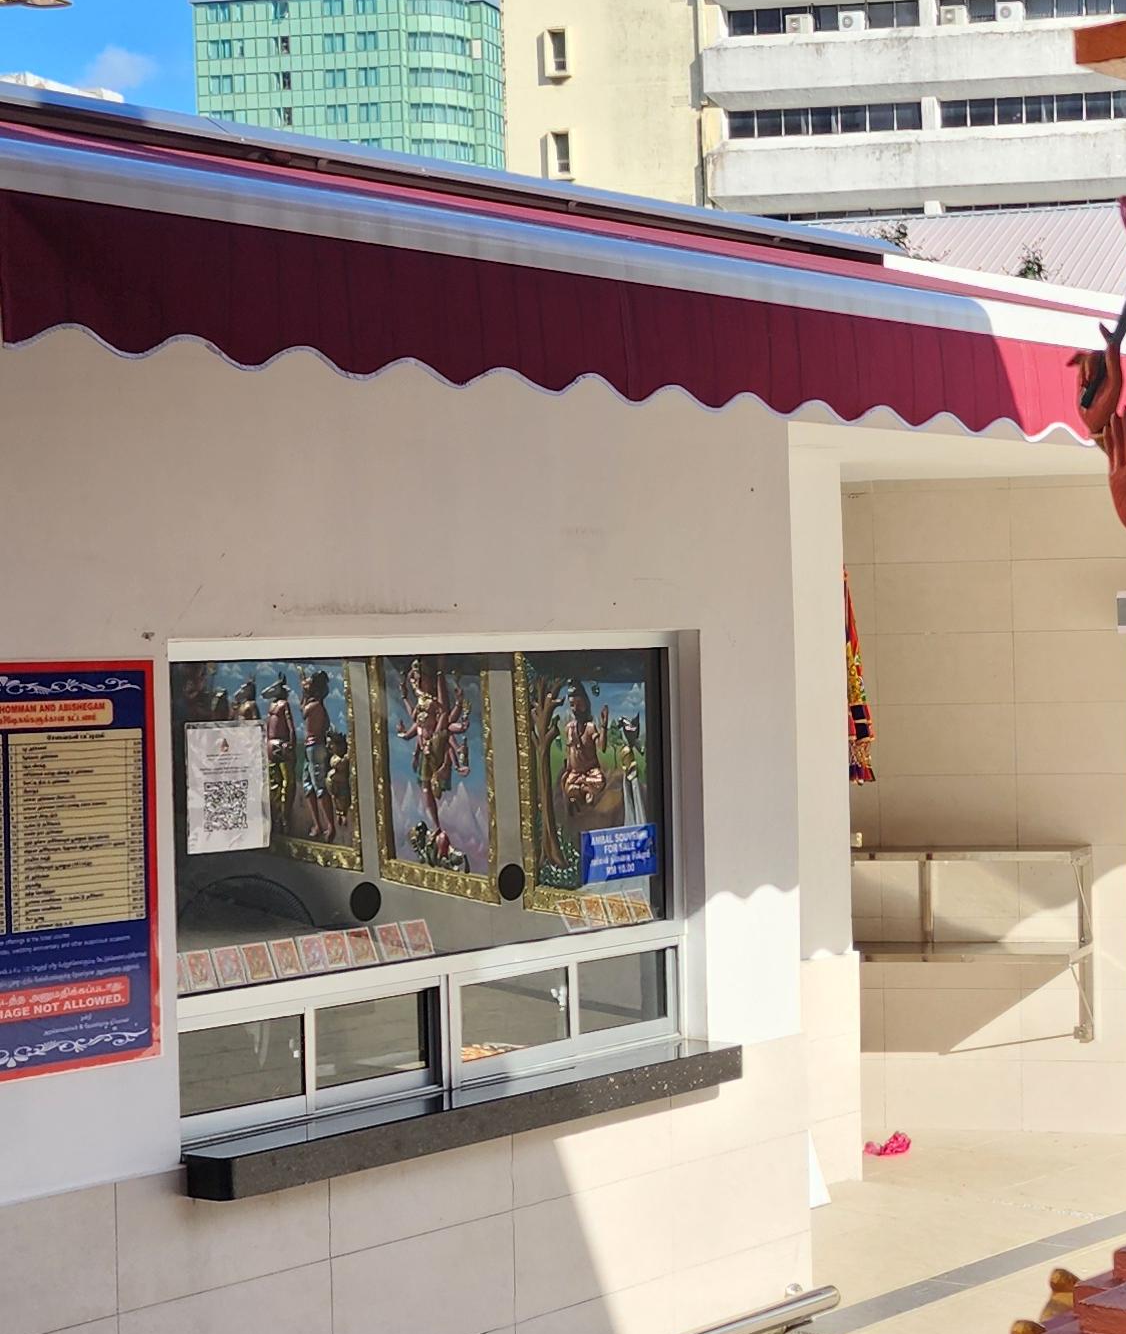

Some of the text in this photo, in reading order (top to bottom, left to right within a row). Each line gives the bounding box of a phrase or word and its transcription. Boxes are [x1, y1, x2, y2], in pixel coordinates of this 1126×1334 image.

[604, 842, 618, 854] FOR
[0, 993, 125, 1019] IAGE NOT ALLOWED.
